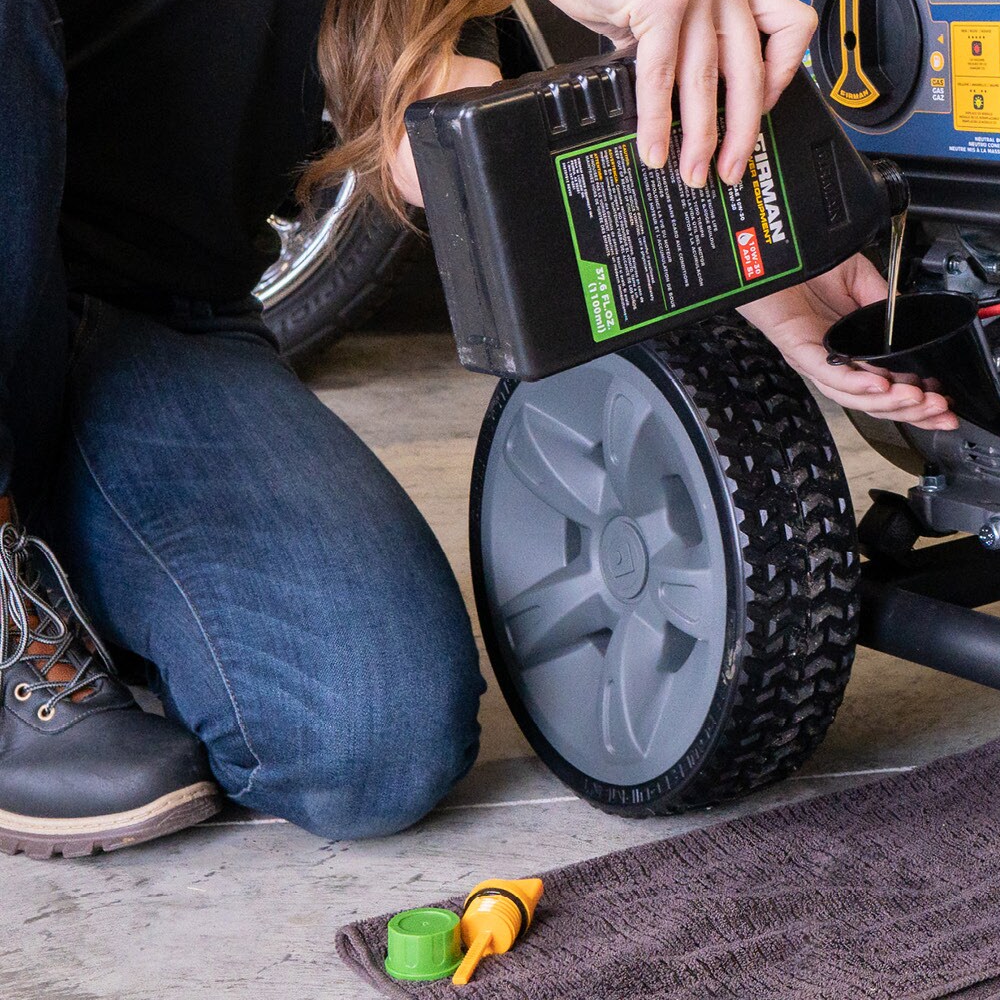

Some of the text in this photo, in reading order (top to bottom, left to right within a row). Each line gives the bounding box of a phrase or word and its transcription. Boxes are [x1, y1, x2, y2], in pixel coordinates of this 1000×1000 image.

[840, 90, 868, 99] FIRMAN
[727, 187, 737, 211] 10W-30
[752, 180, 773, 245] EQUIPMENT
[742, 248, 754, 277] API SL
[749, 241, 762, 276] 10W-30
[587, 282, 606, 333] (1100ml)
[594, 266, 615, 331] 37.6 FL.OZ.
